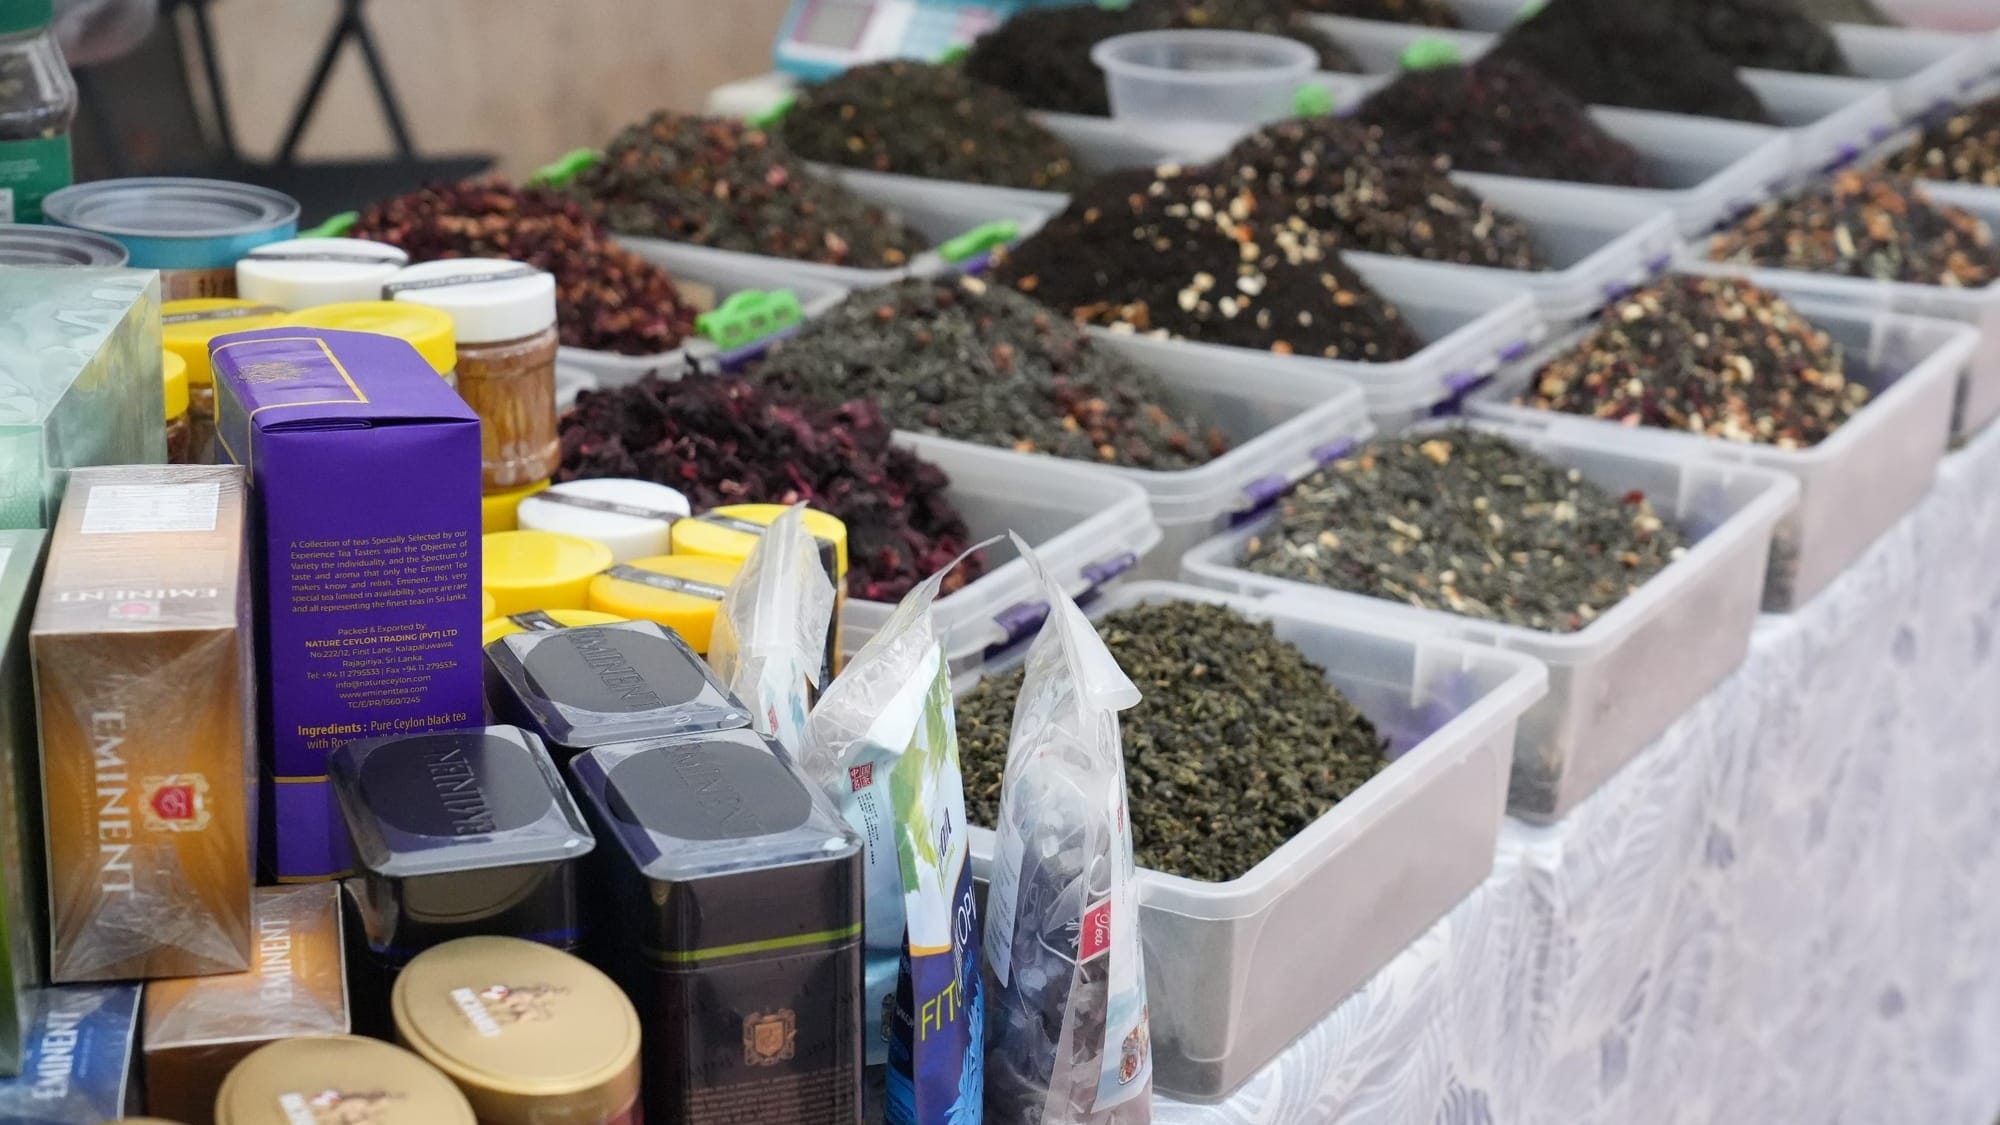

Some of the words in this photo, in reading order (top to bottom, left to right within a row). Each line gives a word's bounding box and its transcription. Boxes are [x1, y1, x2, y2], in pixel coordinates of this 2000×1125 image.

[299, 540, 340, 548] Collection
[372, 535, 405, 546] Specially
[408, 533, 440, 541] Selected
[443, 532, 452, 540] by
[291, 551, 335, 561] Experience
[354, 548, 380, 556] Tasters
[421, 542, 456, 552] Objective
[291, 562, 319, 570] Variety
[389, 556, 403, 564] and
[422, 553, 457, 563] Spectrum
[292, 573, 311, 581] taste
[384, 568, 400, 576] only
[421, 563, 452, 572] Eminent
[292, 594, 319, 604] special
[336, 591, 363, 599] limited
[320, 602, 370, 612] representing
[386, 598, 407, 606] finest
[338, 627, 368, 636] Packed
[378, 624, 414, 634] Exported
[306, 639, 341, 648] NATURE
[343, 637, 377, 645] CEYLON
[380, 633, 417, 643] TRADING
[420, 632, 440, 641] (PVT)
[443, 630, 457, 638] LTD
[353, 648, 370, 656] First
[336, 677, 431, 690] info@natureceylon.com
[340, 688, 428, 699] www.eminenttea.com
[298, 723, 361, 738] Ingredients
[371, 721, 392, 730] Pure
[394, 718, 424, 730] Ceylon
[427, 714, 450, 725] black
[453, 713, 466, 722] tea
[307, 738, 328, 750] with
[424, 740, 497, 833] EMINEN
[92, 711, 135, 900] EMINENT
[1095, 911, 1112, 946] Tea
[260, 919, 293, 1000] EMINENT
[31, 1010, 81, 1099] EMINENT
